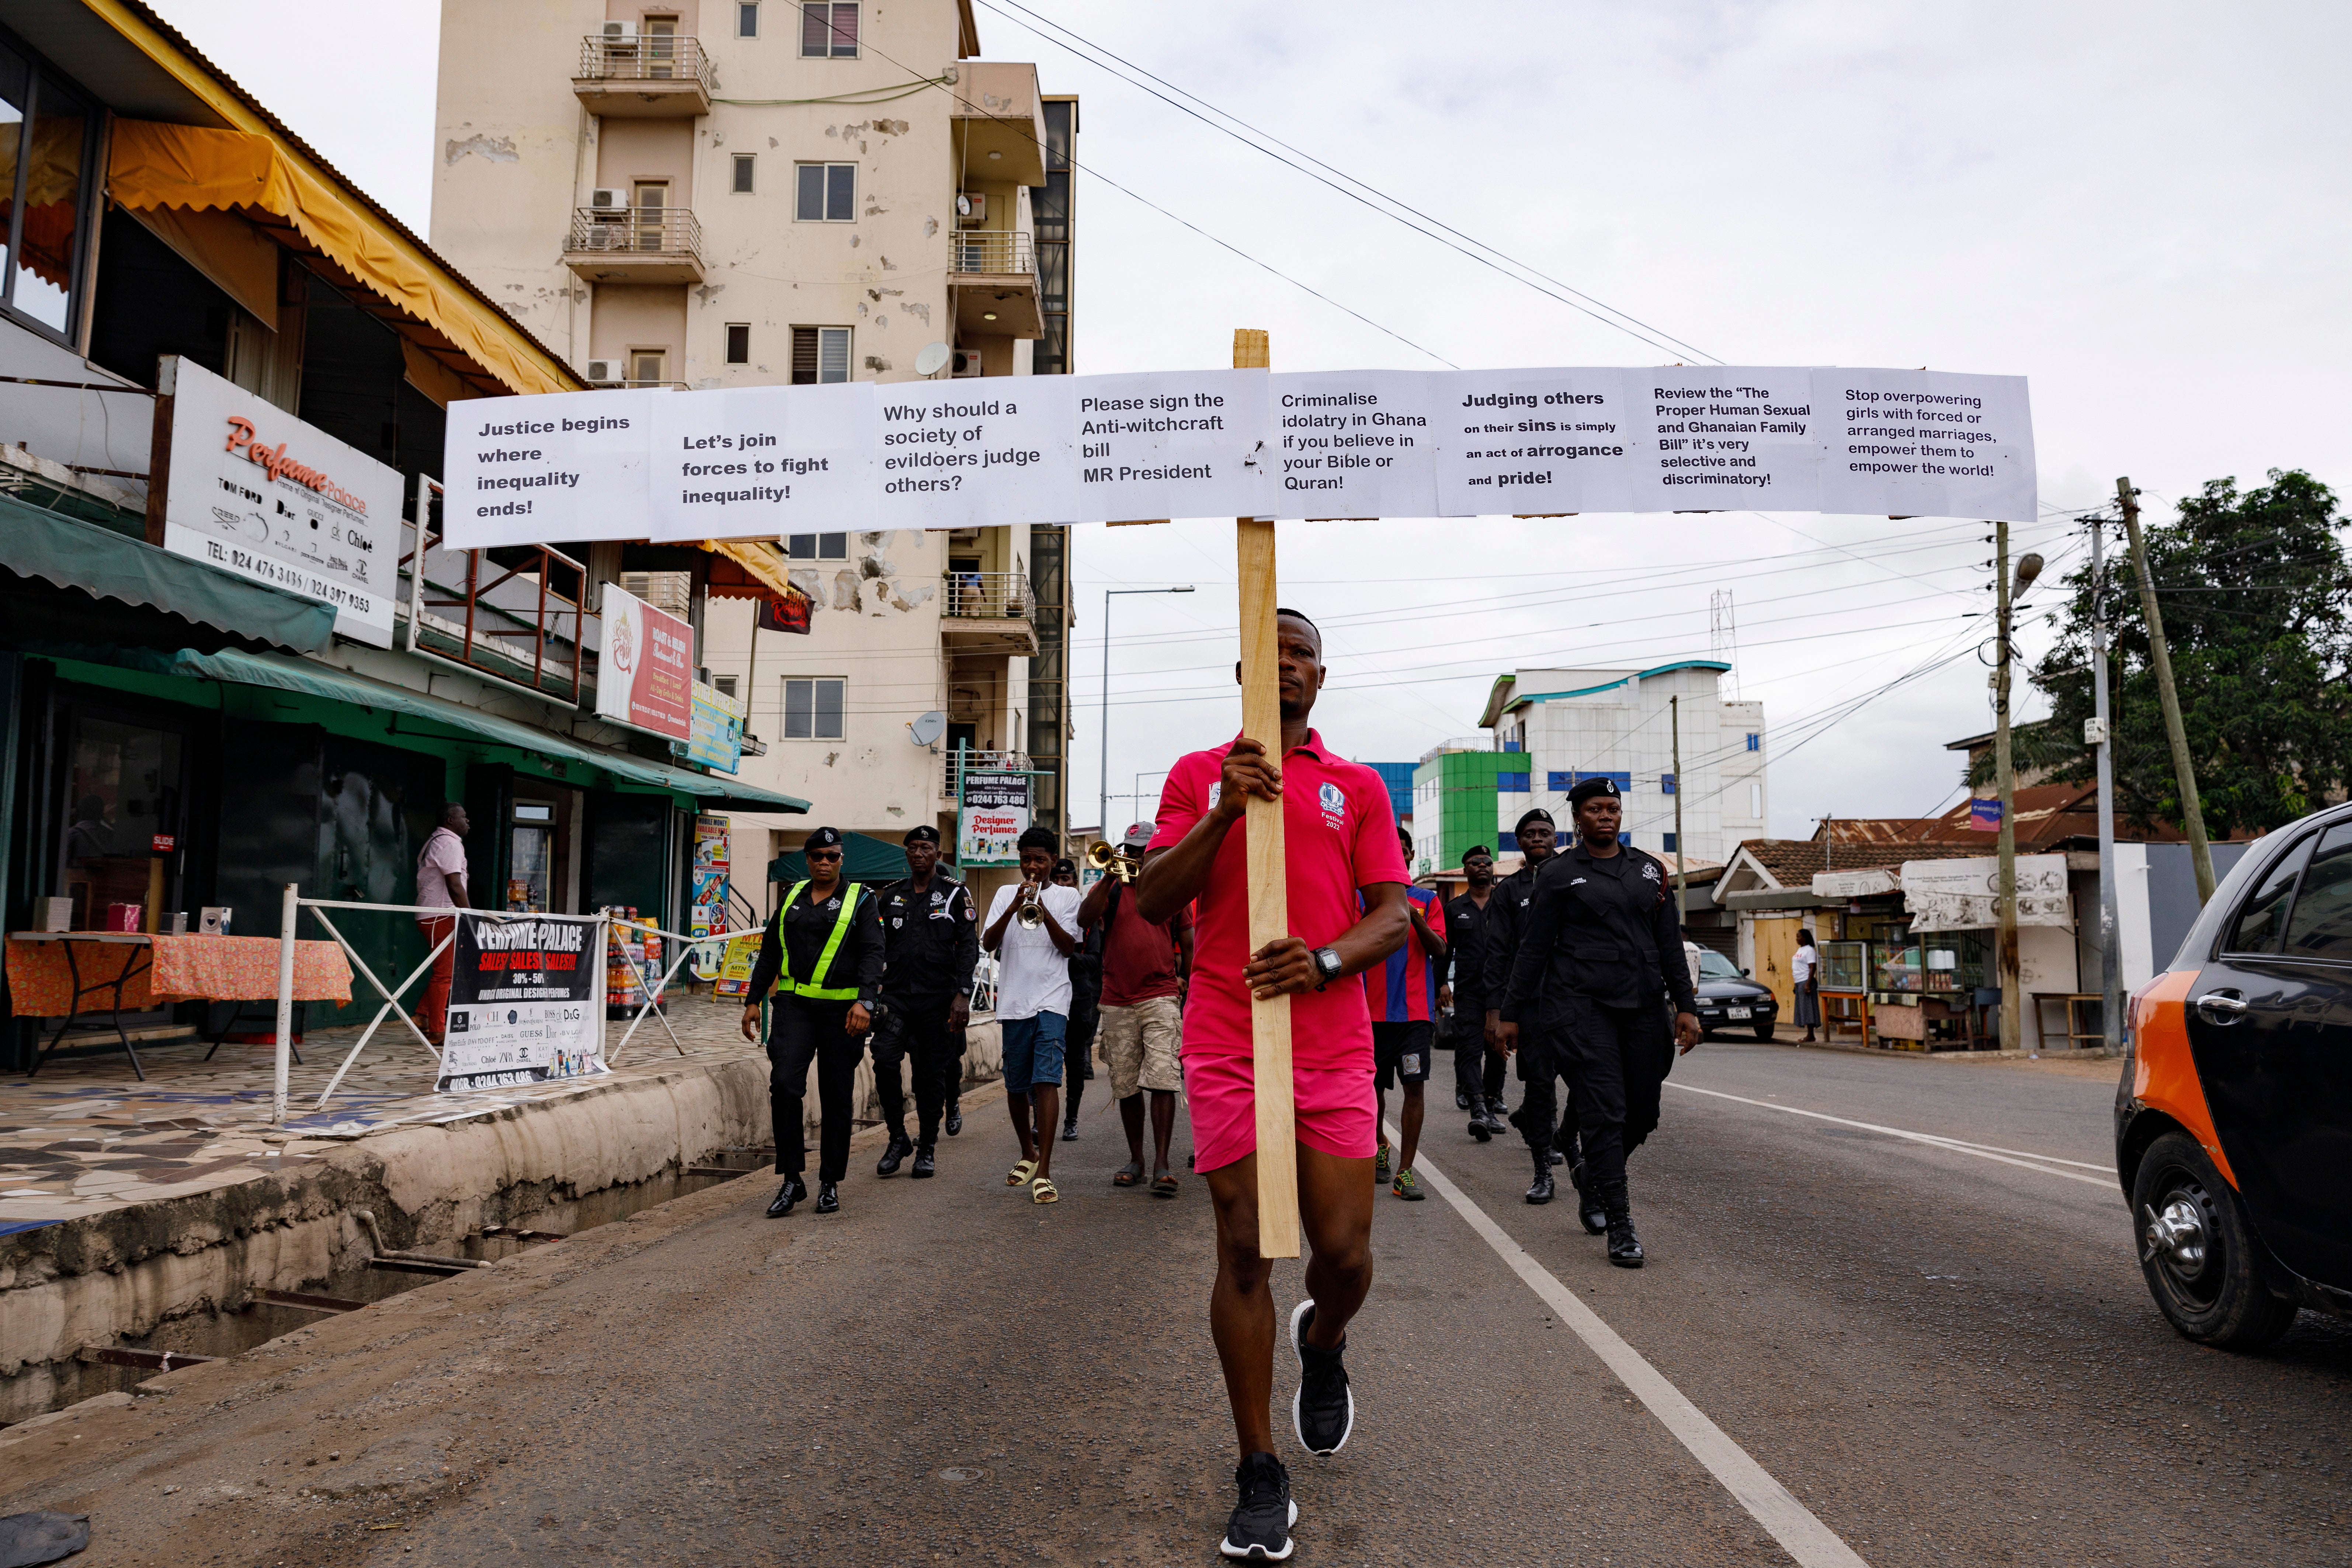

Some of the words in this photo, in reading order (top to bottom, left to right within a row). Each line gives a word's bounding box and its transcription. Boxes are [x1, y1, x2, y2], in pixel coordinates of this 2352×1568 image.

[1282, 393, 1377, 407] Criminalise
[1462, 393, 1537, 408] Judging
[1544, 392, 1604, 404] others
[1654, 388, 1706, 399] Review
[1710, 387, 1733, 398] the
[1846, 390, 1879, 403] Stop
[1884, 393, 1981, 408] overpowering
[1082, 398, 1143, 412] Please
[1150, 394, 1188, 411] sign
[1194, 393, 1223, 407] the
[884, 406, 926, 422] Why
[933, 401, 998, 418] should
[1006, 404, 1017, 414] a
[1656, 405, 1706, 418] Proper
[1710, 404, 1759, 415] Human
[1764, 404, 1810, 415] Sexual
[1847, 407, 1879, 420] girls
[1883, 408, 1912, 420] with
[1916, 409, 1962, 422] forced
[1967, 415, 1981, 423] or
[479, 421, 555, 436] Justice
[562, 417, 629, 433] begins
[1082, 416, 1224, 435] Anti-witchcraft
[1283, 414, 1347, 430] idolatry
[1352, 413, 1366, 425] in
[1372, 413, 1426, 426] Ghana
[1484, 424, 1514, 432] their
[1518, 419, 1556, 431] sins
[1575, 423, 1616, 433] simply
[1658, 422, 1684, 433] and
[1689, 421, 1756, 432] Ghanaian
[1761, 422, 1806, 435] Family
[739, 434, 776, 451] join
[885, 428, 956, 445] society
[963, 425, 983, 441] of
[1284, 435, 1294, 448] if
[1298, 438, 1328, 451] you
[1334, 434, 1394, 447] believe
[1400, 434, 1413, 446] in
[1848, 427, 1914, 439] arranged
[1920, 430, 1996, 443] marriages,
[1083, 442, 1109, 458] bill
[1486, 449, 1507, 457] act
[1511, 448, 1523, 457] of
[1527, 444, 1623, 459] arrogance
[1718, 441, 1749, 452] very
[1849, 445, 1917, 456] empower
[1921, 445, 1956, 457] them
[1960, 447, 1974, 458] to
[478, 449, 542, 462] where
[886, 452, 977, 469] evildoers
[982, 448, 1040, 468] judge
[1284, 459, 1322, 472] your
[1328, 453, 1370, 468] Bible
[1376, 458, 1393, 467] or
[1661, 456, 1726, 467] selective
[1730, 456, 1755, 467] and
[226, 416, 327, 491] Perfume
[327, 480, 366, 513] Palace
[682, 463, 747, 476] forces
[754, 460, 774, 473] to
[781, 458, 828, 474] fight
[1850, 463, 1918, 474] empower
[1922, 463, 1945, 474] the
[1949, 465, 1994, 476] world!
[478, 472, 580, 491] inequality
[1084, 467, 1113, 483] MR
[1120, 465, 1212, 480] President
[1469, 476, 1491, 485] and
[1498, 471, 1552, 487] pride!
[1663, 473, 1771, 487] discriminatory!
[886, 476, 962, 493] others?
[1285, 476, 1342, 490] Quran!
[218, 478, 237, 494] TOM
[240, 487, 262, 504] FORD
[300, 489, 319, 504] Original
[683, 486, 789, 505] inequality!
[275, 499, 295, 520] Dior
[307, 509, 323, 521] GUCCI
[477, 501, 532, 517] ends!
[348, 530, 372, 553] Chloé
[208, 541, 227, 562] TEL:
[231, 550, 251, 570] 024
[330, 587, 346, 604] 397
[349, 594, 369, 613] 9353
[352, 573, 368, 584] CHANEL
[653, 627, 667, 645] ROAST
[653, 672, 668, 685] Breakfast
[673, 681, 681, 690] Lunch
[674, 694, 684, 703] Drinks
[966, 776, 999, 785] PERFUME
[1000, 776, 1026, 785] PALACE
[973, 795, 992, 803] 0244
[994, 795, 1008, 804] 763
[1009, 796, 1025, 804] 486
[973, 815, 1016, 826] Designer
[1321, 812, 1344, 825] Festival
[1326, 820, 1340, 831] 2022
[972, 824, 1017, 835] Perfumes
[154, 836, 174, 845] SLIDE
[477, 921, 536, 950] PERFUME
[538, 923, 582, 951] PALACE
[479, 953, 509, 970] SALES!
[546, 953, 577, 970] SALES!!!
[513, 973, 527, 984] 30%
[496, 988, 522, 999] ORIGINAL
[548, 987, 570, 998] PERFUMES
[487, 1011, 498, 1022] CH
[545, 1010, 555, 1018] BOSS
[564, 1009, 580, 1020] D&G
[545, 1025, 556, 1039] Dior
[481, 1056, 496, 1064] Chloé
[500, 1052, 513, 1063] ZARA
[475, 1074, 498, 1089] 0244
[498, 1072, 516, 1085] 763
[515, 1071, 534, 1084] 486
